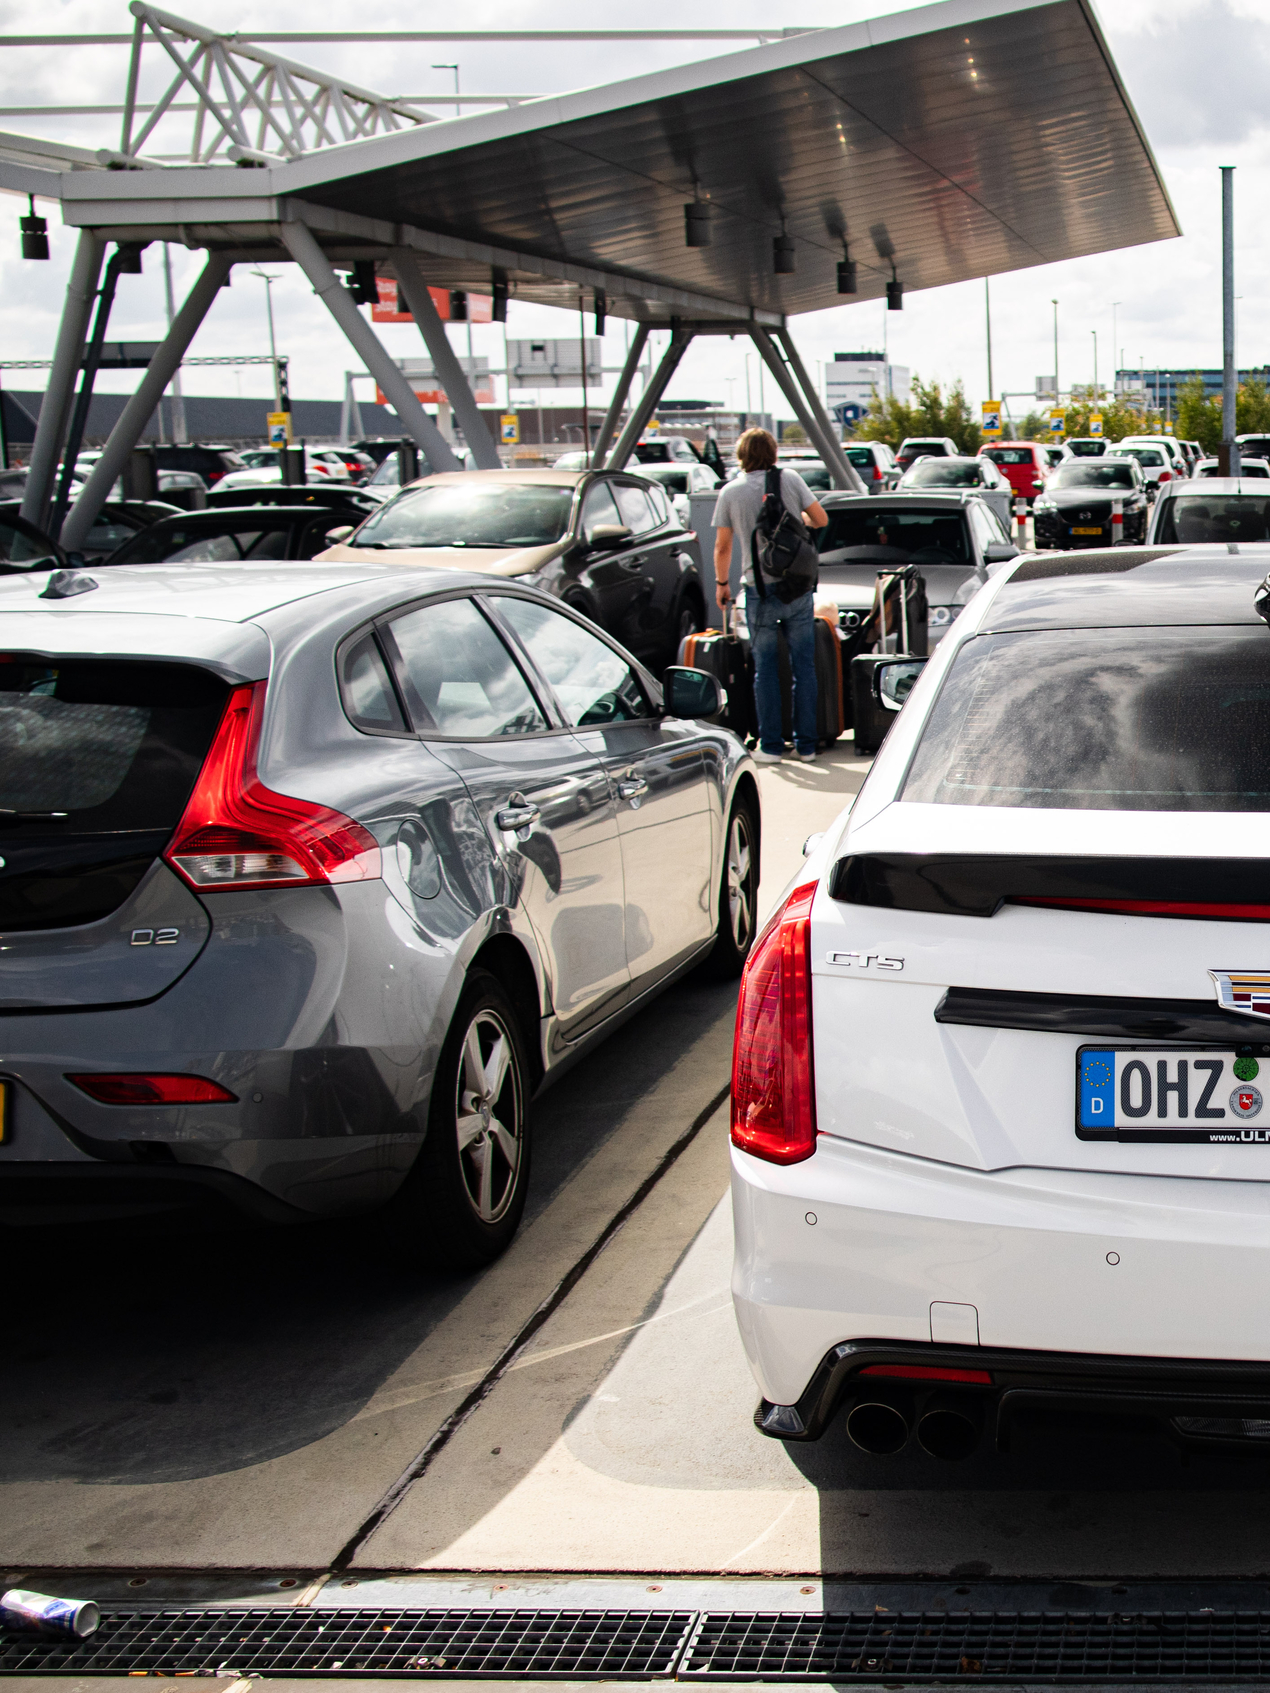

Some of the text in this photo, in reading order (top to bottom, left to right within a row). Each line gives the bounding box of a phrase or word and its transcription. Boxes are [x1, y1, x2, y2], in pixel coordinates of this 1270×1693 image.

[130, 927, 180, 946] D2
[825, 950, 905, 971] CTS
[1090, 1097, 1104, 1114] D
[1120, 1059, 1226, 1119] OHZ
